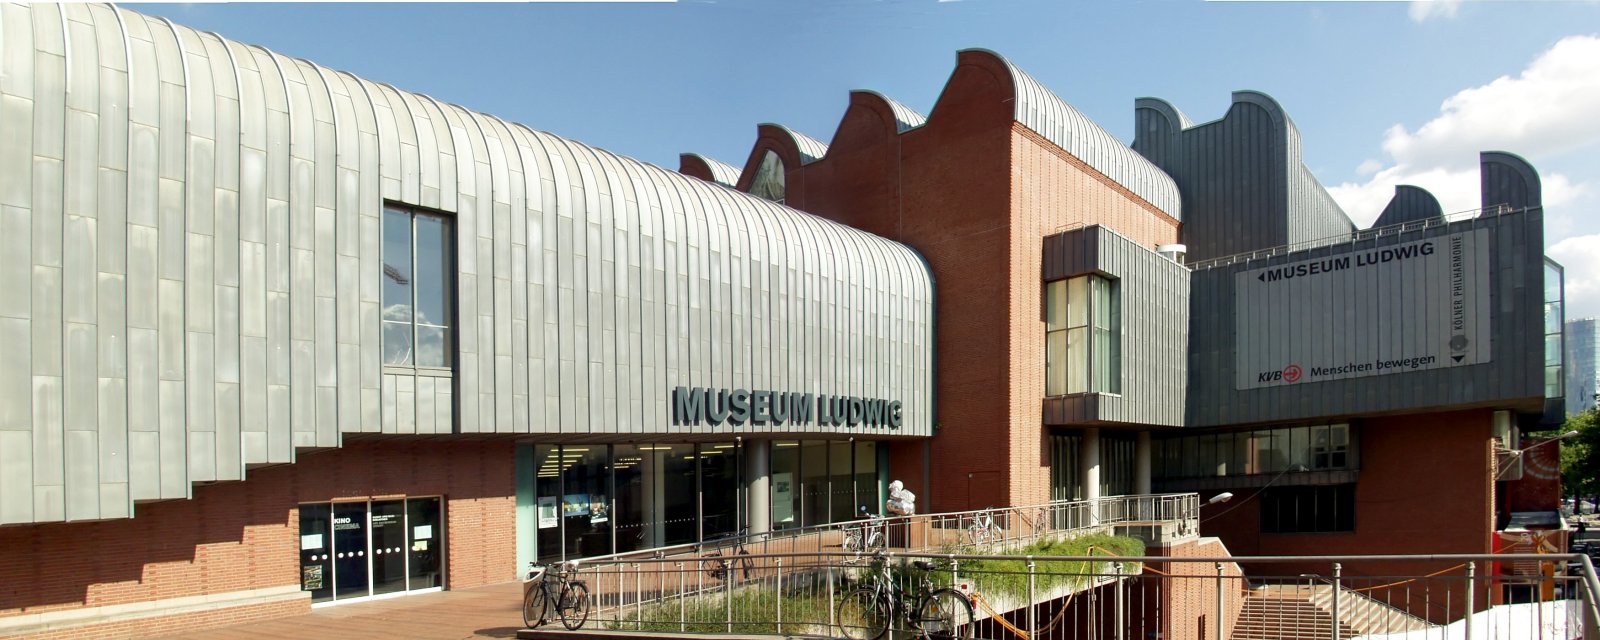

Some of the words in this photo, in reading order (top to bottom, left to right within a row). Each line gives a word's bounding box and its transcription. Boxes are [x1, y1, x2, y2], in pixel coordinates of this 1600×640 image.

[1268, 257, 1350, 282] MUSEUM
[1357, 242, 1434, 267] LUDWIG
[1453, 236, 1463, 297] PHILHARMONIE
[1258, 370, 1282, 382] KVB
[1310, 362, 1372, 377] Menschen
[1376, 355, 1435, 370] bewegen
[673, 386, 811, 426] MUSEUM
[817, 394, 903, 429] LUDWIG
